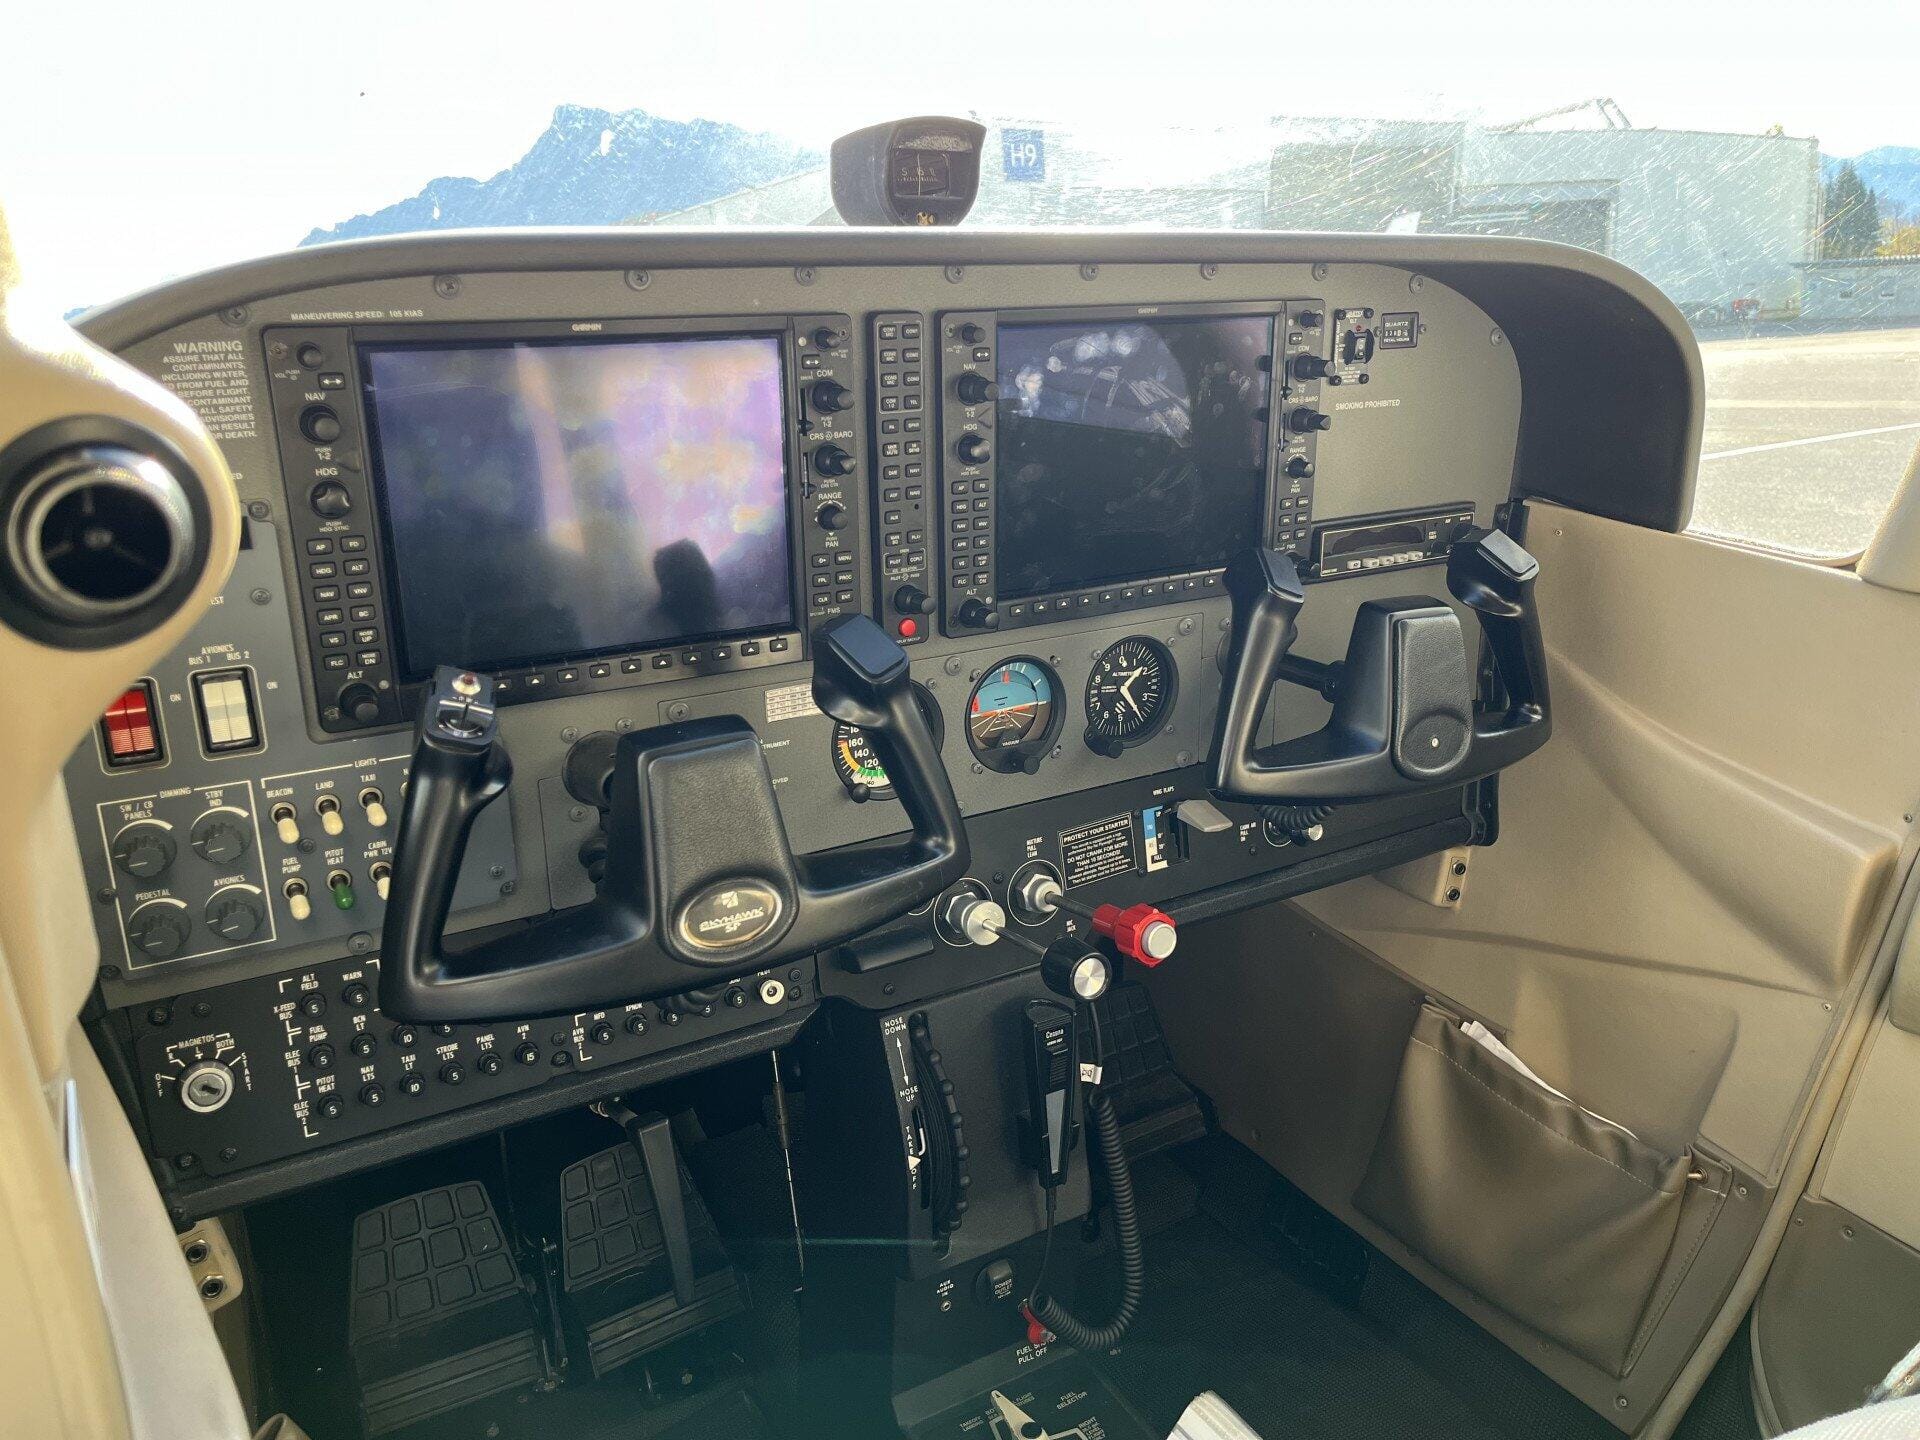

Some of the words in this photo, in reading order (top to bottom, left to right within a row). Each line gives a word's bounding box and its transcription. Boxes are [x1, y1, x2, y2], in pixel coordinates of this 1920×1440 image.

[1010, 143, 1037, 168] H9
[291, 311, 353, 321] MANEUVERING
[173, 340, 243, 353] WARNING
[162, 354, 200, 364] ASSURE
[202, 353, 225, 362] THAT
[227, 352, 245, 361] ALL
[963, 363, 976, 371] NAV
[161, 372, 211, 382] INCLUDING
[817, 369, 833, 377] COM
[176, 381, 203, 390] FROM
[204, 380, 228, 388] FUEL
[230, 378, 249, 387] AND
[304, 392, 326, 401] NAV
[218, 404, 253, 414] SAFETY
[1335, 401, 1363, 411] SMOKING
[1364, 399, 1401, 408] PROHIBITED
[221, 421, 256, 431] RESULT
[963, 423, 977, 431] HDG
[315, 467, 338, 477] HDG
[818, 491, 842, 500] RANGE
[825, 540, 839, 548] PAN
[966, 588, 977, 596] ALT
[201, 643, 235, 655] AVIONICS
[188, 656, 204, 665] BUS
[226, 652, 241, 661] BUS
[244, 651, 250, 659] 2
[1104, 663, 1111, 672] 9
[1142, 666, 1148, 675] 2
[347, 670, 364, 680] ALT
[1095, 675, 1101, 683] 8
[1142, 692, 1148, 701] 3
[1095, 702, 1101, 711] 7
[1103, 710, 1109, 719] 6
[1117, 713, 1123, 722] 5
[849, 737, 864, 747] 160
[854, 748, 869, 758] 140
[354, 758, 377, 768] LIGHTS
[864, 758, 879, 768] 120
[360, 773, 376, 783] TAXI
[315, 780, 335, 790] LAND
[159, 786, 192, 799] DIMMING
[205, 789, 224, 799] STBY
[266, 787, 294, 798] BEACON
[209, 798, 223, 807] IND
[124, 810, 152, 820] PANELS
[1063, 830, 1089, 843] PROTECT
[1089, 826, 1104, 836] YOUR
[1105, 819, 1129, 831] STARTER
[367, 840, 387, 850] CABIN
[324, 848, 344, 858] PITOT
[1067, 856, 1075, 864] DO
[1075, 853, 1086, 862] NOT
[1086, 848, 1104, 858] CRANK
[1103, 845, 1114, 853] FOR
[1114, 840, 1129, 850] MORE
[282, 857, 299, 867] FUEL
[327, 856, 344, 866] HEAT
[1076, 859, 1090, 867] THAN
[282, 865, 302, 875] PUMP
[213, 874, 246, 887] AVIONICS
[135, 888, 171, 901] PEDESTAL
[699, 906, 765, 930] SKYHAWK
[302, 973, 315, 982] ALT
[343, 970, 363, 982] WARN
[301, 980, 319, 991] FIELD
[356, 994, 362, 1003] 5
[736, 996, 742, 1004] 5
[273, 1002, 296, 1014] X-FEED
[279, 1011, 293, 1020] BUS
[672, 1013, 678, 1022] 5
[638, 1023, 644, 1031] 5
[884, 1016, 904, 1029] NOSE
[309, 1024, 326, 1034] FUEL
[884, 1022, 907, 1036] DOWN
[178, 1033, 215, 1049] MAGNETOS
[309, 1031, 328, 1043] PUMP
[403, 1034, 412, 1043] 10
[476, 1034, 495, 1045] PANEL
[603, 1032, 609, 1041] 5
[216, 1038, 235, 1049] BOTH
[362, 1044, 369, 1053] 5
[436, 1042, 459, 1055] STROBE
[480, 1041, 493, 1051] LTS
[285, 1050, 301, 1060] ELEC
[320, 1055, 327, 1065] 5
[400, 1054, 416, 1064] TAXI
[442, 1052, 454, 1061] LTS
[526, 1053, 535, 1061] 15
[287, 1058, 301, 1068] BUS
[490, 1062, 497, 1071] 5
[360, 1065, 375, 1075] NAV
[316, 1075, 335, 1086] PITOT
[362, 1072, 375, 1082] LTS
[452, 1072, 459, 1081] 5
[318, 1082, 335, 1093] HEAT
[411, 1083, 420, 1092] 10
[899, 1085, 919, 1098] NOSE
[372, 1093, 379, 1102] 5
[905, 1093, 916, 1103] UP
[293, 1100, 309, 1111] ELEC
[330, 1105, 337, 1115] 5
[296, 1108, 309, 1119] BUS
[936, 1283, 954, 1294] AUDIO
[1016, 1345, 1033, 1357] FUEL
[1018, 1352, 1035, 1365] PULL
[1035, 1347, 1048, 1358] OFF
[1056, 1390, 1088, 1410] SELECTOR
[1060, 1391, 1076, 1402] FUEL
